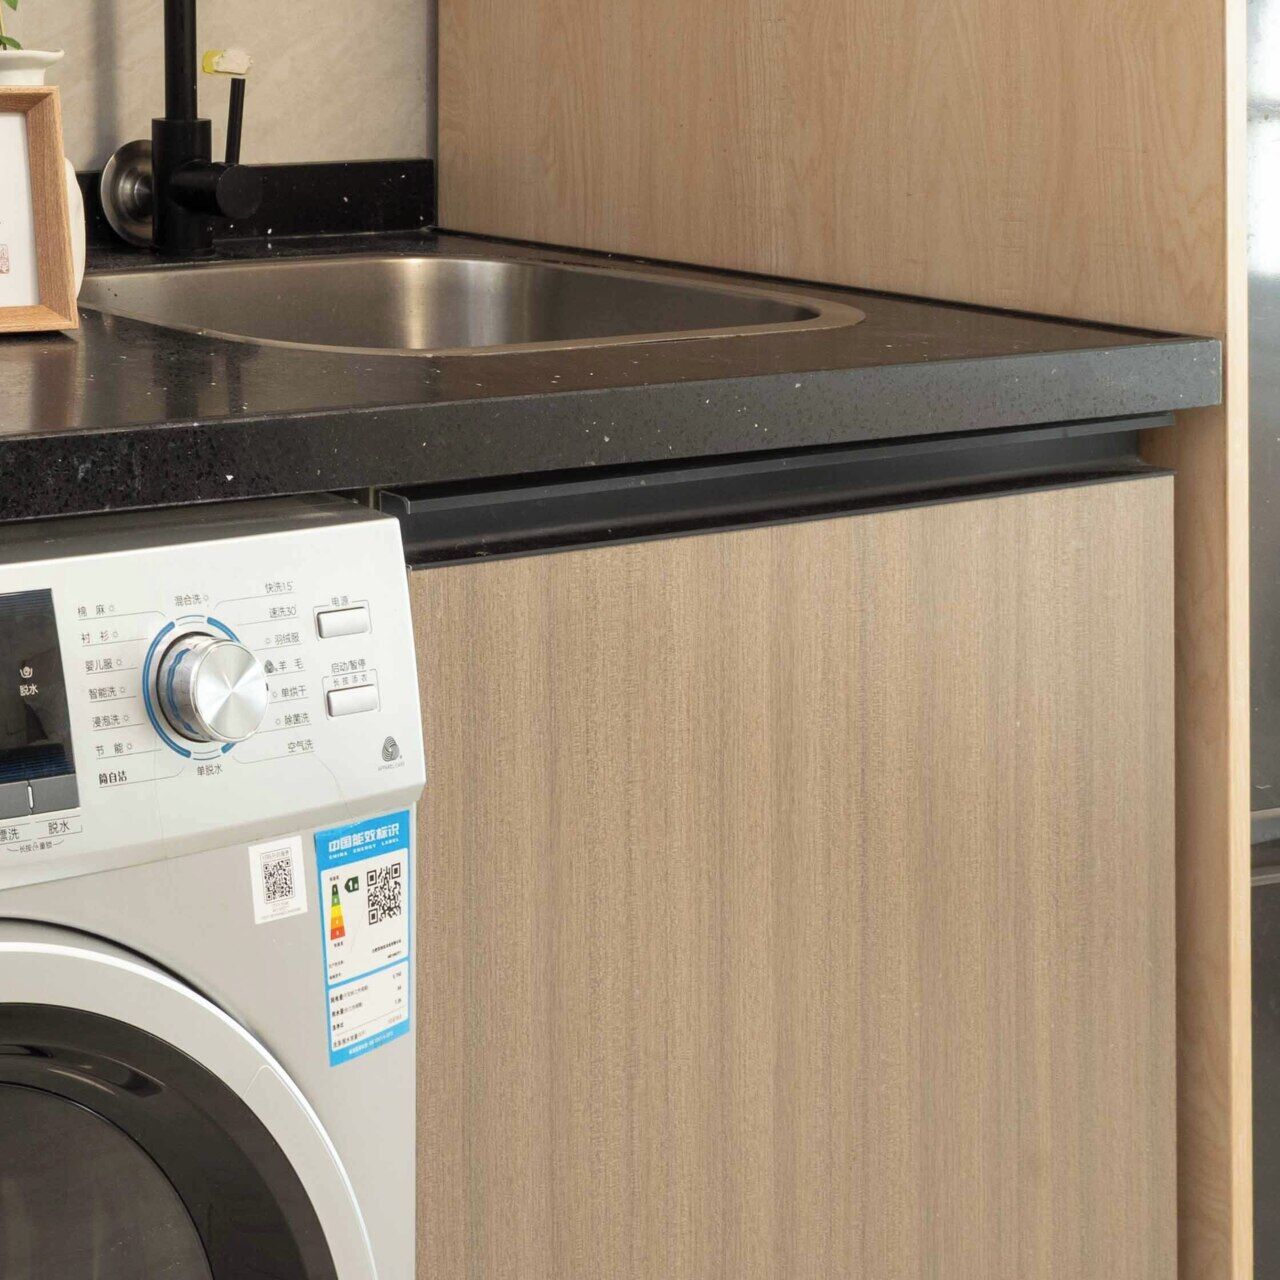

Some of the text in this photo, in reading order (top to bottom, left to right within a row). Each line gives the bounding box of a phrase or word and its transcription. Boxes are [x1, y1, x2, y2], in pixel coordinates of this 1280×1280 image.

[175, 594, 201, 607] 混合洗
[331, 596, 349, 606] 电源
[274, 632, 300, 645] 羽绒服
[85, 658, 113, 672] 婴儿服
[331, 658, 366, 674] 启动/暂停
[19, 684, 39, 697] 脱水
[89, 686, 117, 700] 智能洗
[281, 685, 307, 697] 单烘干
[92, 714, 121, 728] 浸泡洗
[284, 713, 310, 725] 除菌洗
[288, 739, 314, 752] 空气洗
[196, 763, 223, 777] 单脱水
[98, 771, 128, 785] 筒自洁
[48, 820, 70, 835] 脱水
[328, 823, 399, 853] 中国能效标识
[353, 843, 377, 853] ENERGY
